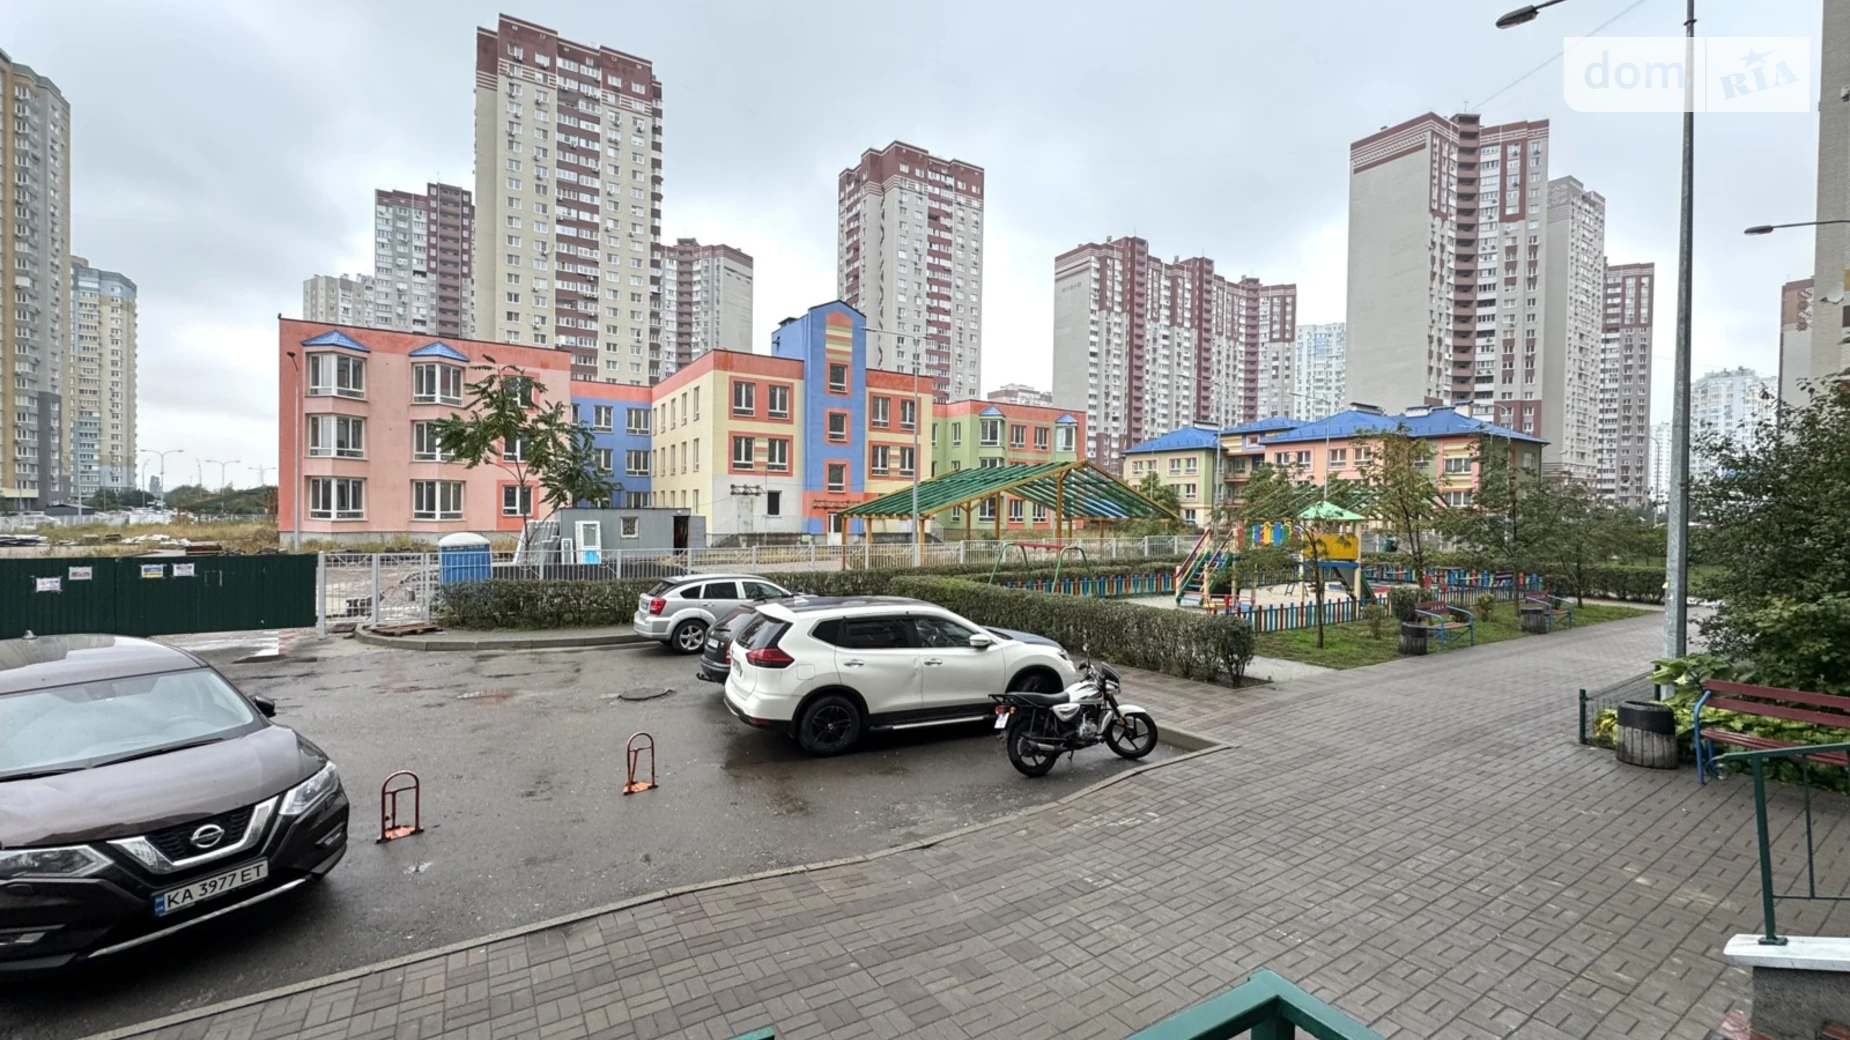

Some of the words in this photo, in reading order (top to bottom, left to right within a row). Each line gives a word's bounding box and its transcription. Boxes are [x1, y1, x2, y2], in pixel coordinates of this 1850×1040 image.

[168, 889, 193, 907] KA
[199, 873, 237, 897] 3977
[241, 863, 264, 882] ET
